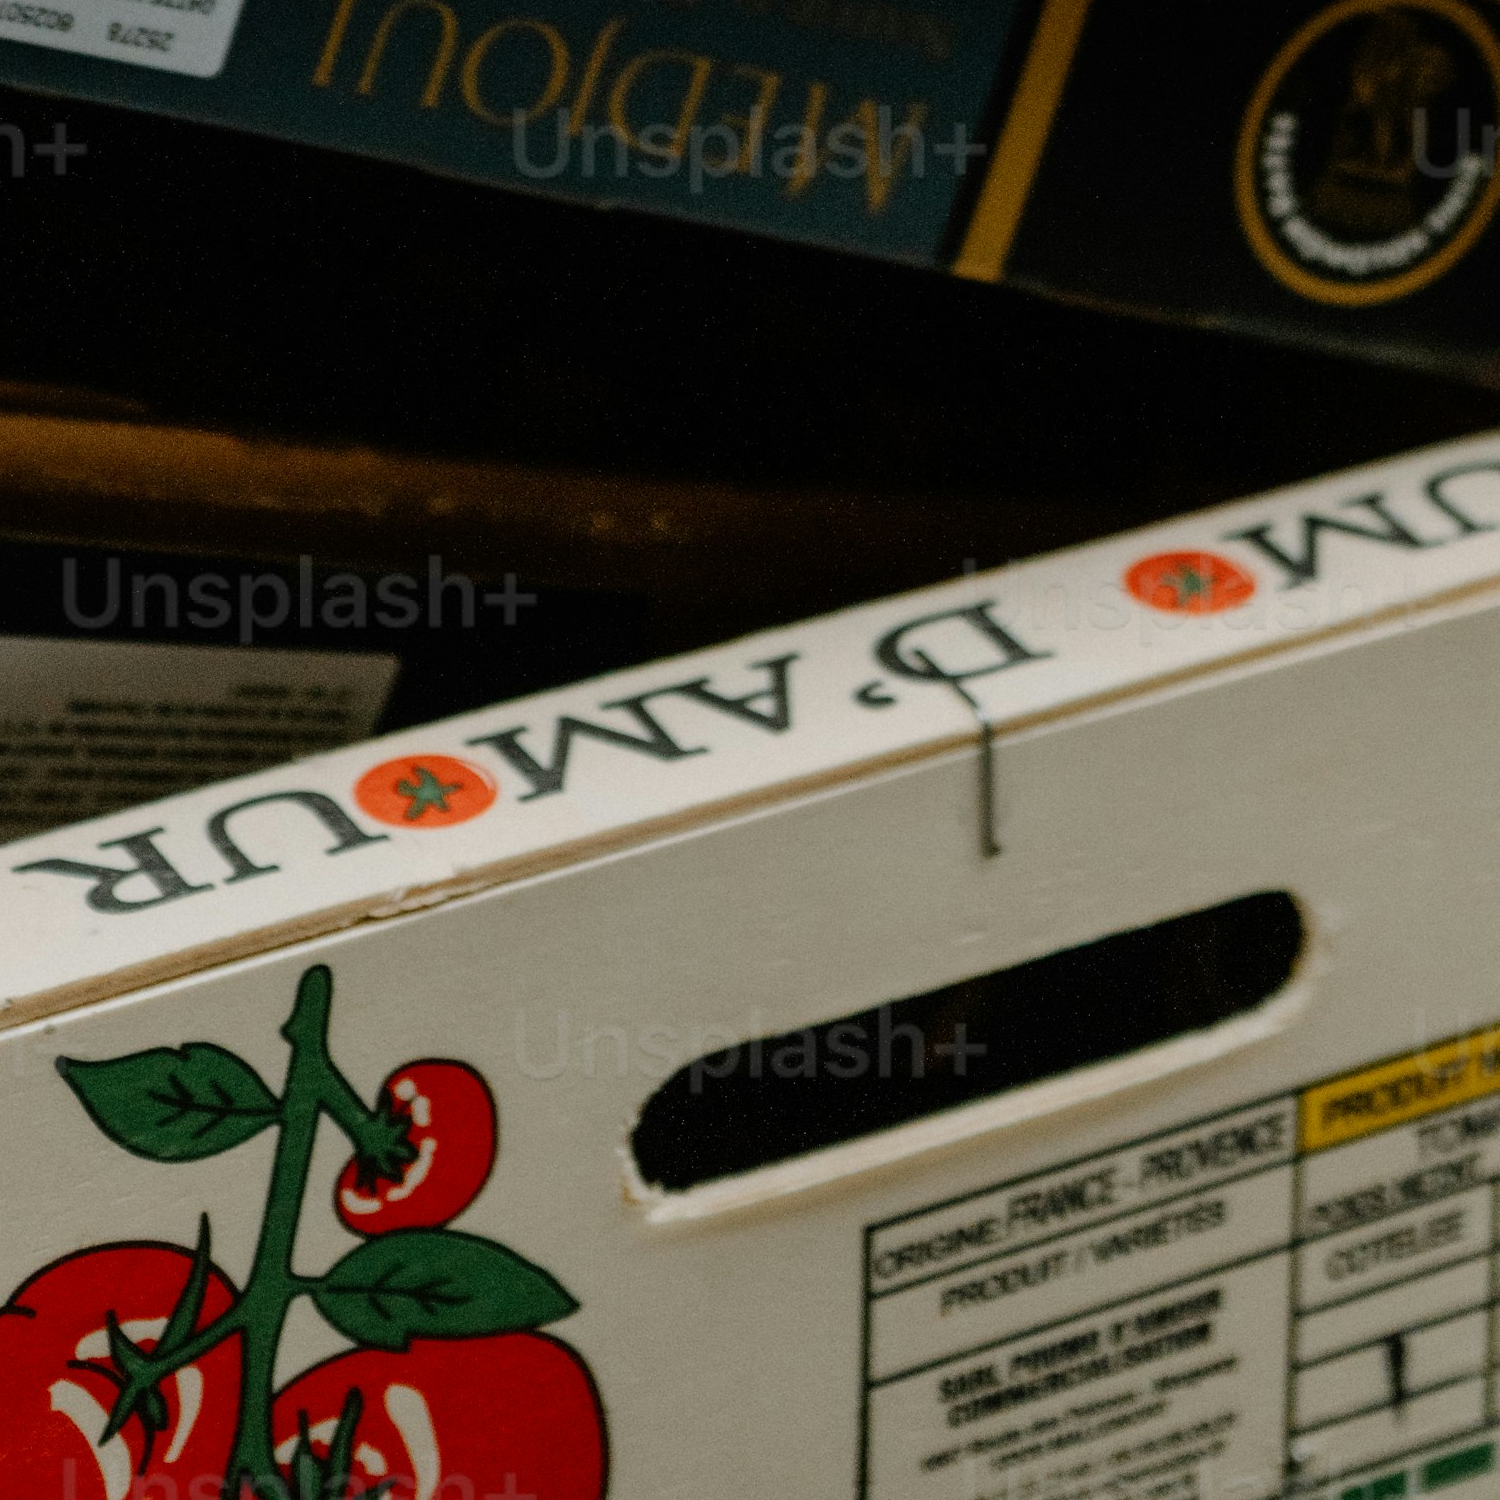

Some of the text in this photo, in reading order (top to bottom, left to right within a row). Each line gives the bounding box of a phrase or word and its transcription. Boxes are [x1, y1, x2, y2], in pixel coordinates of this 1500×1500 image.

[1009, 1169, 1112, 1224] FRANCE
[1143, 1114, 1283, 1179] PROVENCE
[942, 1252, 1066, 1308] PRODUIT
